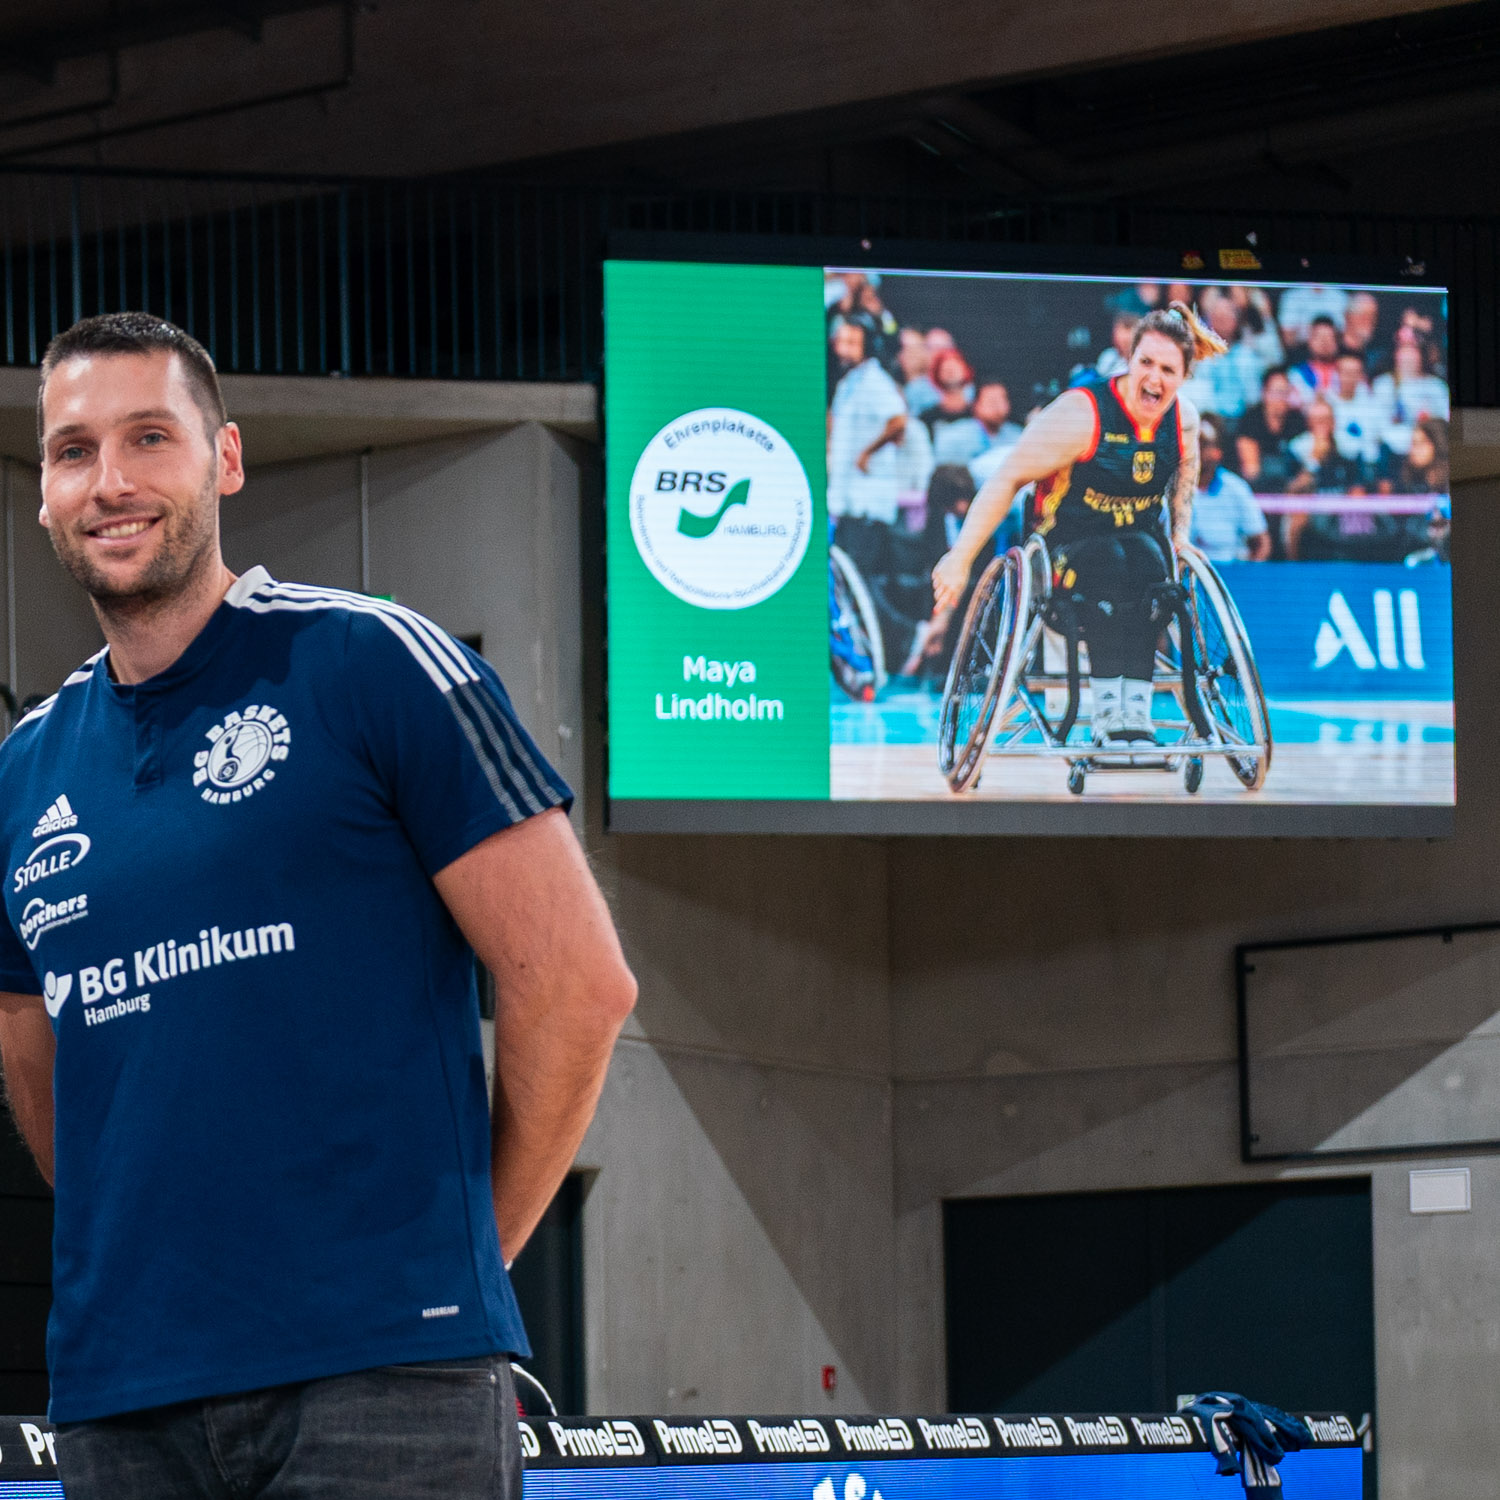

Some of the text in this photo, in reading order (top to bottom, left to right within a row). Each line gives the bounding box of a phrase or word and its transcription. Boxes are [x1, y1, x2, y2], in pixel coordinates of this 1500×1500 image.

[663, 418, 775, 453] Ehrenplakette
[655, 471, 727, 493] BRS
[683, 656, 755, 687] Maya
[655, 691, 783, 722] Lindholm
[205, 704, 291, 760] BASKETS
[201, 768, 275, 804] HAMBURG
[32, 814, 78, 838] adidas
[19, 893, 88, 939] borchers
[79, 922, 295, 1005] BG Klinikum
[84, 993, 151, 1027] Hamburg
[548, 1420, 646, 1457] PrimeLED
[653, 1419, 743, 1455] PrimeLED
[747, 1419, 831, 1453] PrimeLED
[835, 1418, 915, 1452] PrimeLED
[917, 1417, 991, 1450] PrimeLED
[994, 1417, 1062, 1448] PrimeLED
[1064, 1416, 1128, 1446] PrimeLED
[1131, 1416, 1193, 1445] PrimeLED
[1304, 1415, 1356, 1442] PrimeLED
